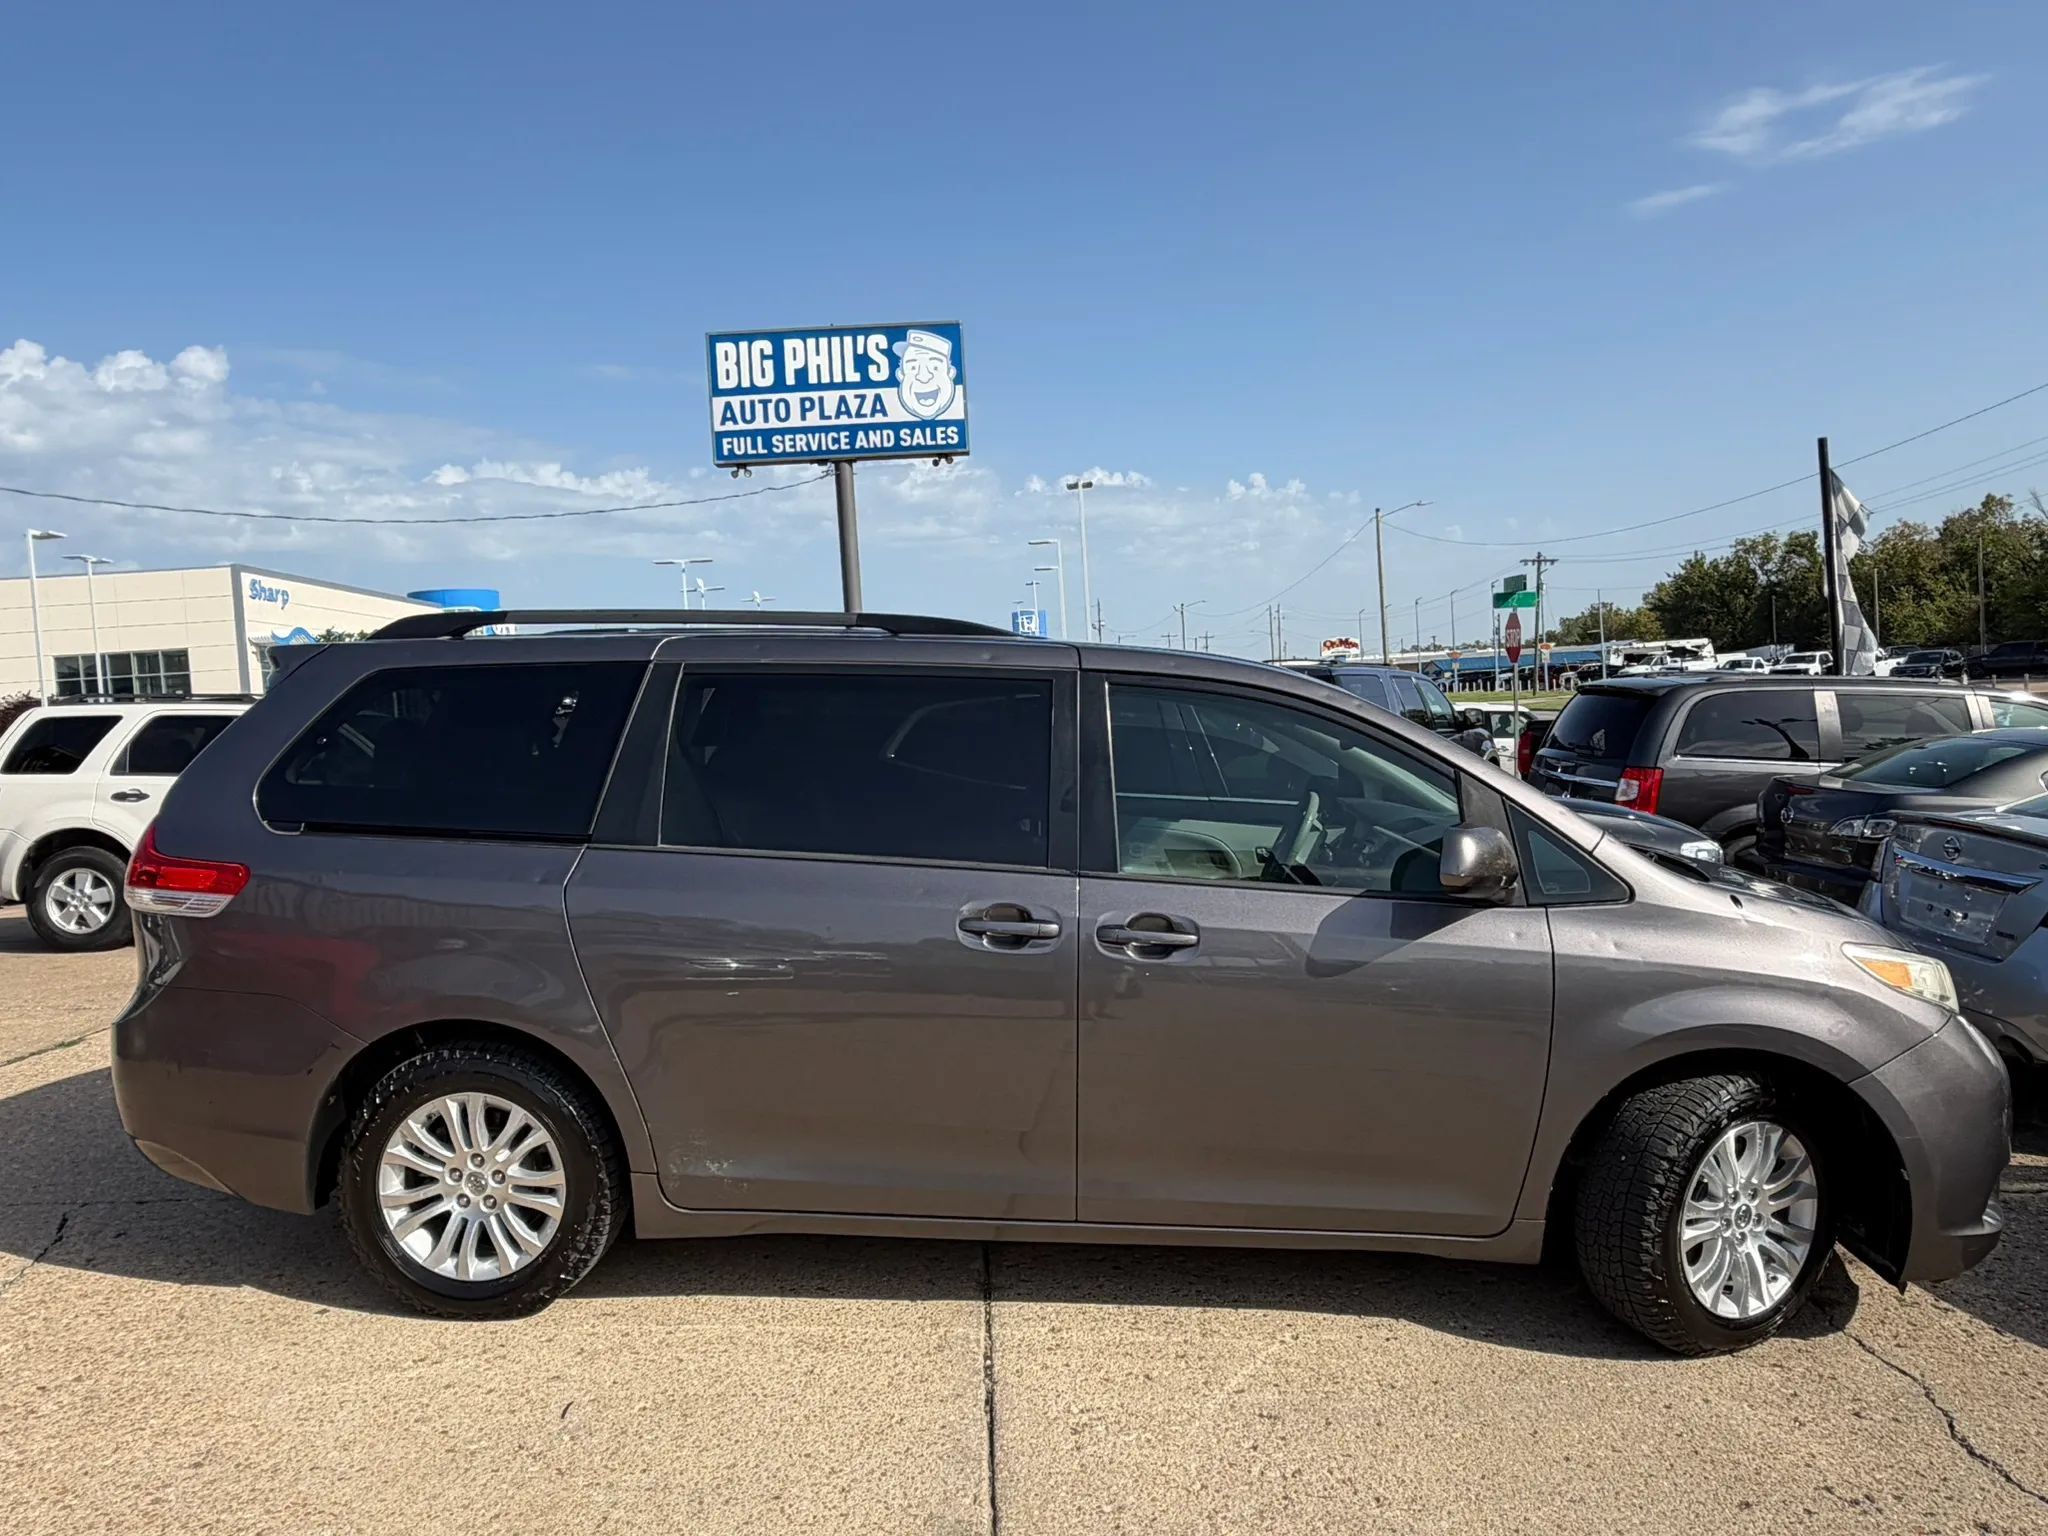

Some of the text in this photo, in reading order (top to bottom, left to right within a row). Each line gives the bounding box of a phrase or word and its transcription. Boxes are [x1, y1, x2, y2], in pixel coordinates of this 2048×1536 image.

[715, 333, 890, 389] BIG PHIL'S
[720, 392, 889, 426] AUTO PLAZA
[722, 426, 959, 456] FULL SERVICE AND SALES
[249, 578, 290, 610] Sharp
[1506, 628, 1520, 648] STOP
